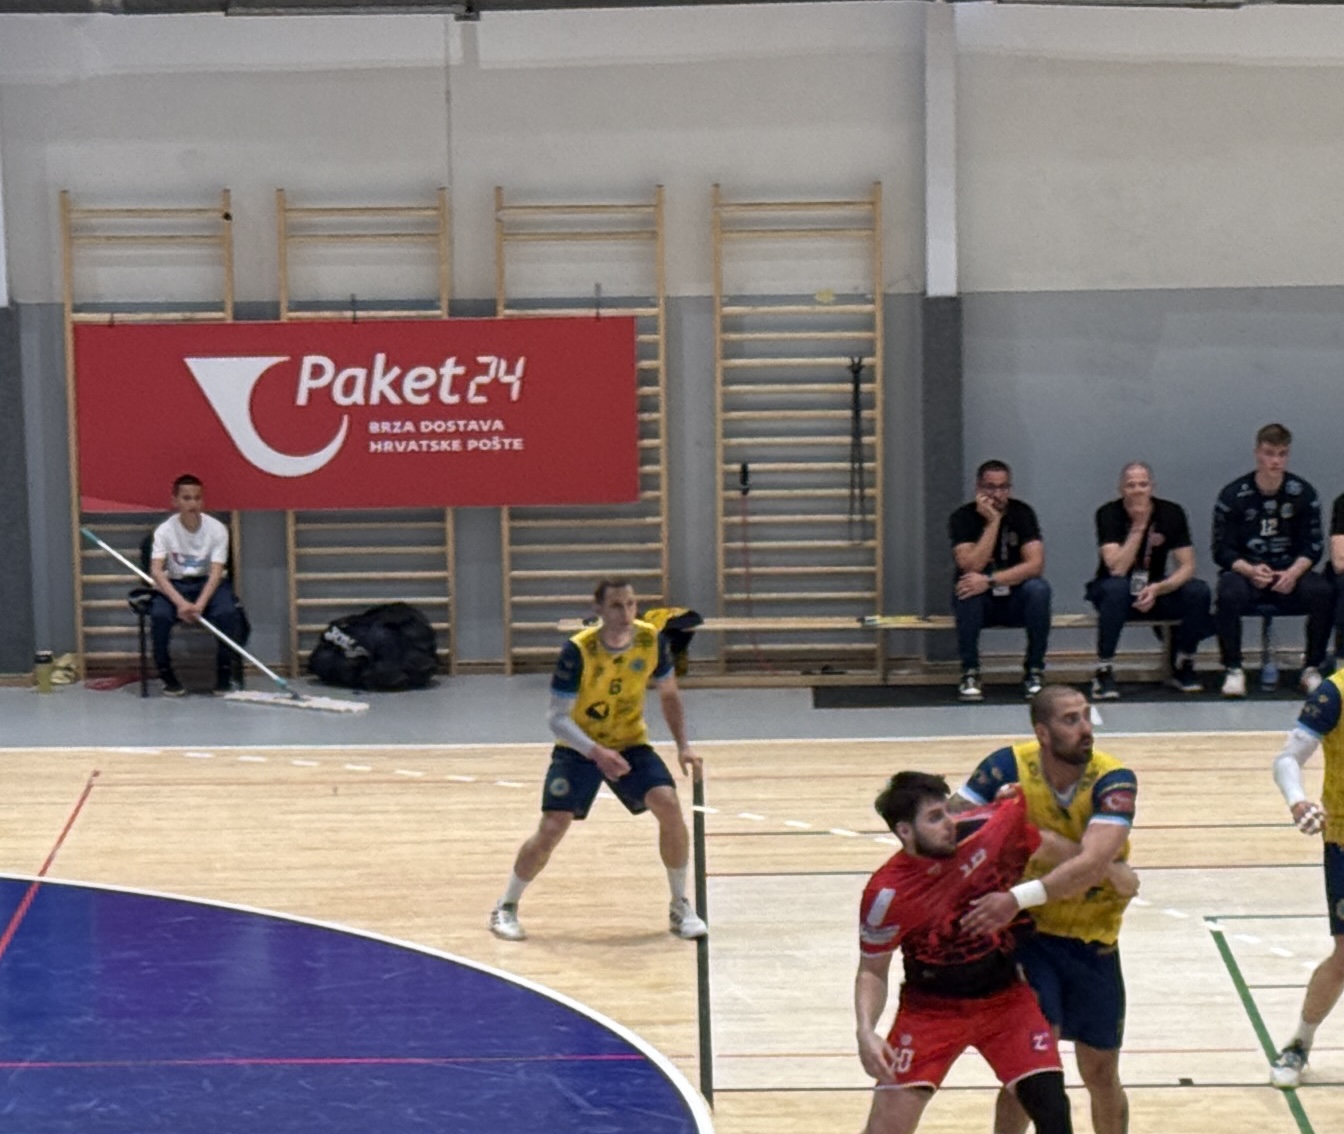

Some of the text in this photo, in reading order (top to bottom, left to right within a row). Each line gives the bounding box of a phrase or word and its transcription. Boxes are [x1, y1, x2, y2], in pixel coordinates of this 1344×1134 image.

[369, 418, 504, 434] BRZA DOSTAVA
[369, 435, 524, 453] HRVATSKE POŠTE
[1260, 518, 1278, 536] 12
